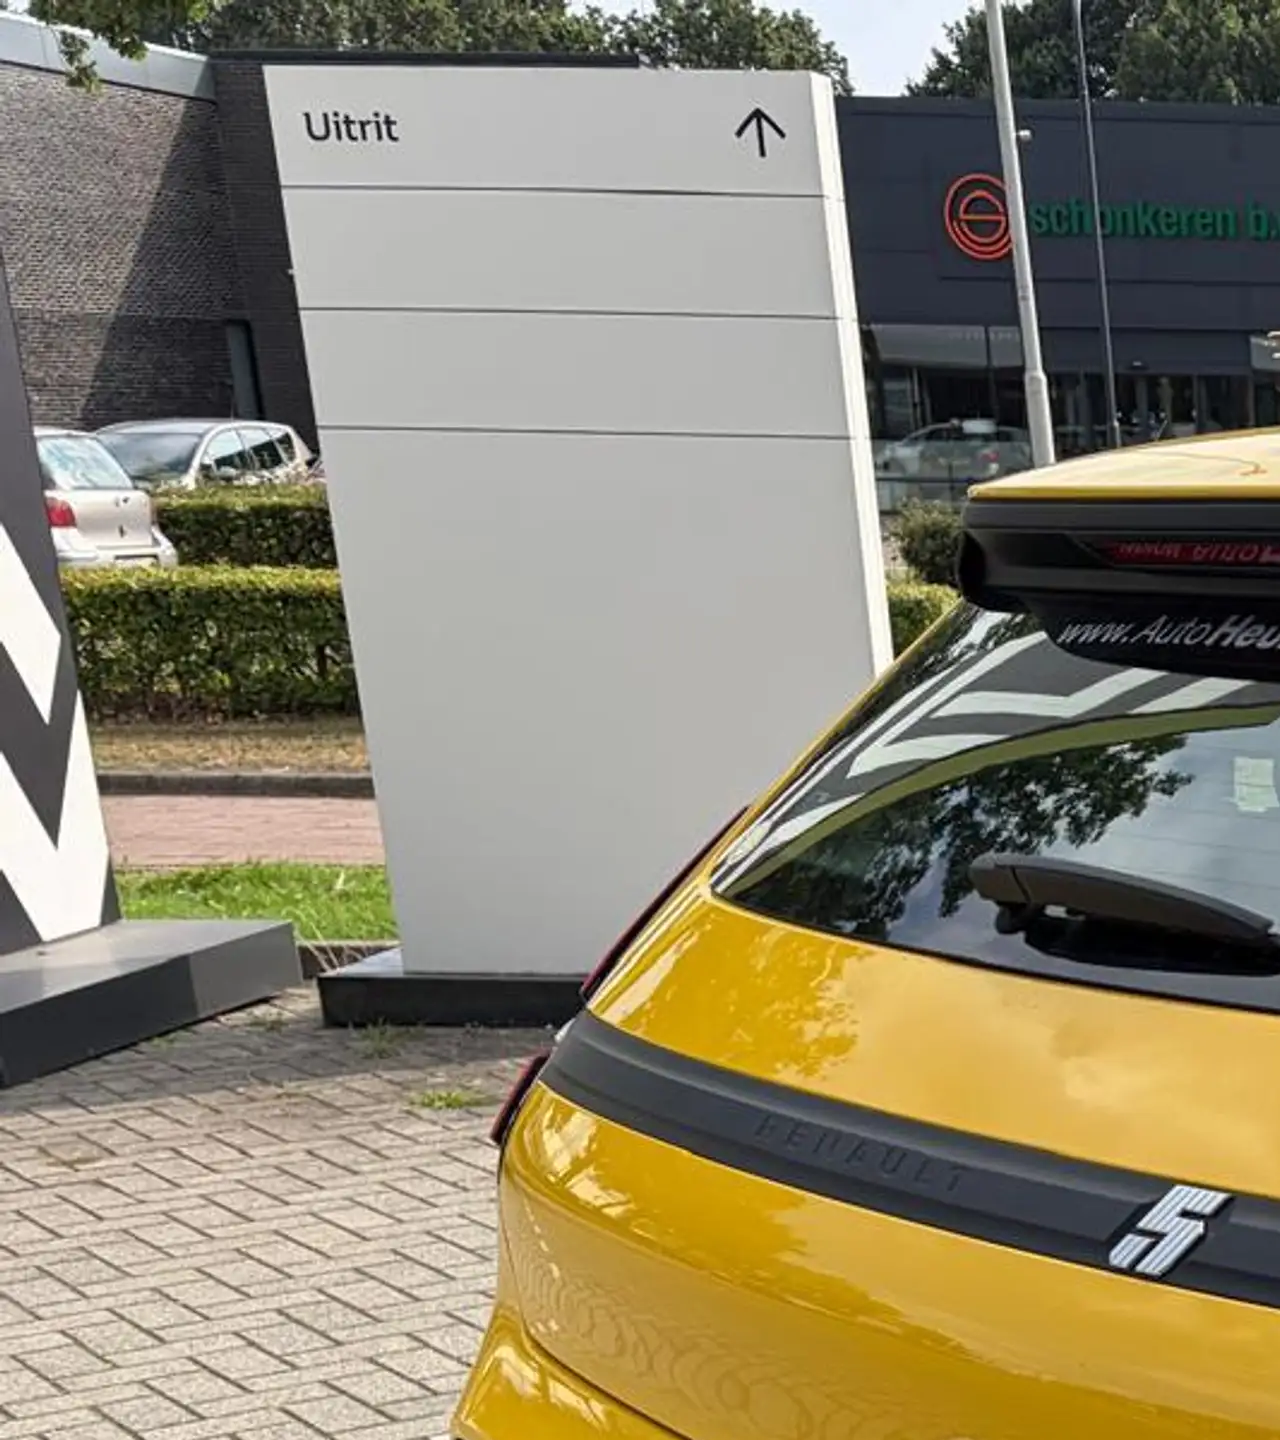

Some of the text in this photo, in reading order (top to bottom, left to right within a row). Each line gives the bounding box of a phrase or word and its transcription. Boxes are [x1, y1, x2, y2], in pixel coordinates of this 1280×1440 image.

[302, 110, 399, 142] Uitrit
[1029, 198, 1237, 238] schonkeren
[754, 1114, 972, 1192] RENAULT
